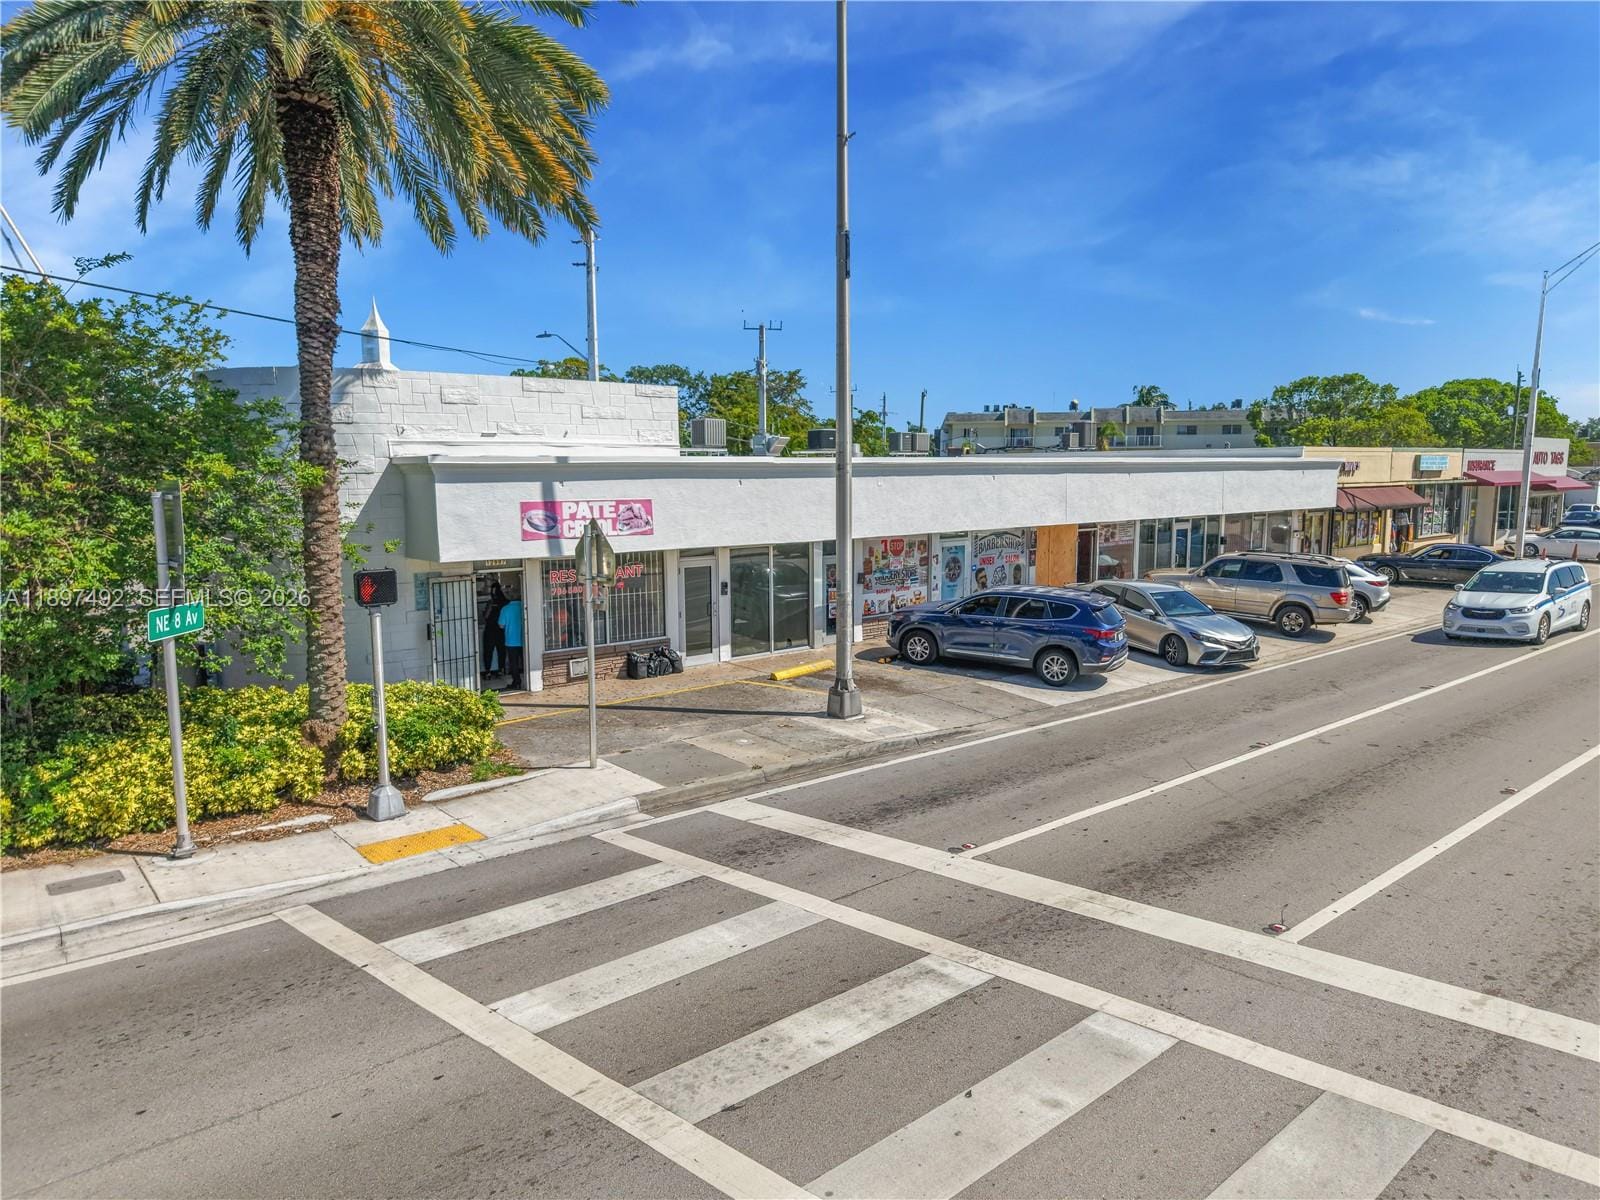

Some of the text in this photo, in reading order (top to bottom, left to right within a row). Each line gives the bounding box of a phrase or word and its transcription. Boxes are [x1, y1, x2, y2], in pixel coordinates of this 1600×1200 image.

[1533, 452, 1565, 465] AUTO TAGS
[562, 501, 617, 519] PATE
[563, 519, 618, 537] CROL
[889, 542, 905, 551] STOP
[979, 536, 1021, 555] BARBERSHOP
[979, 555, 996, 566] UNISEX
[550, 564, 643, 584] RESANT
[156, 609, 198, 633] NE 8 Av
